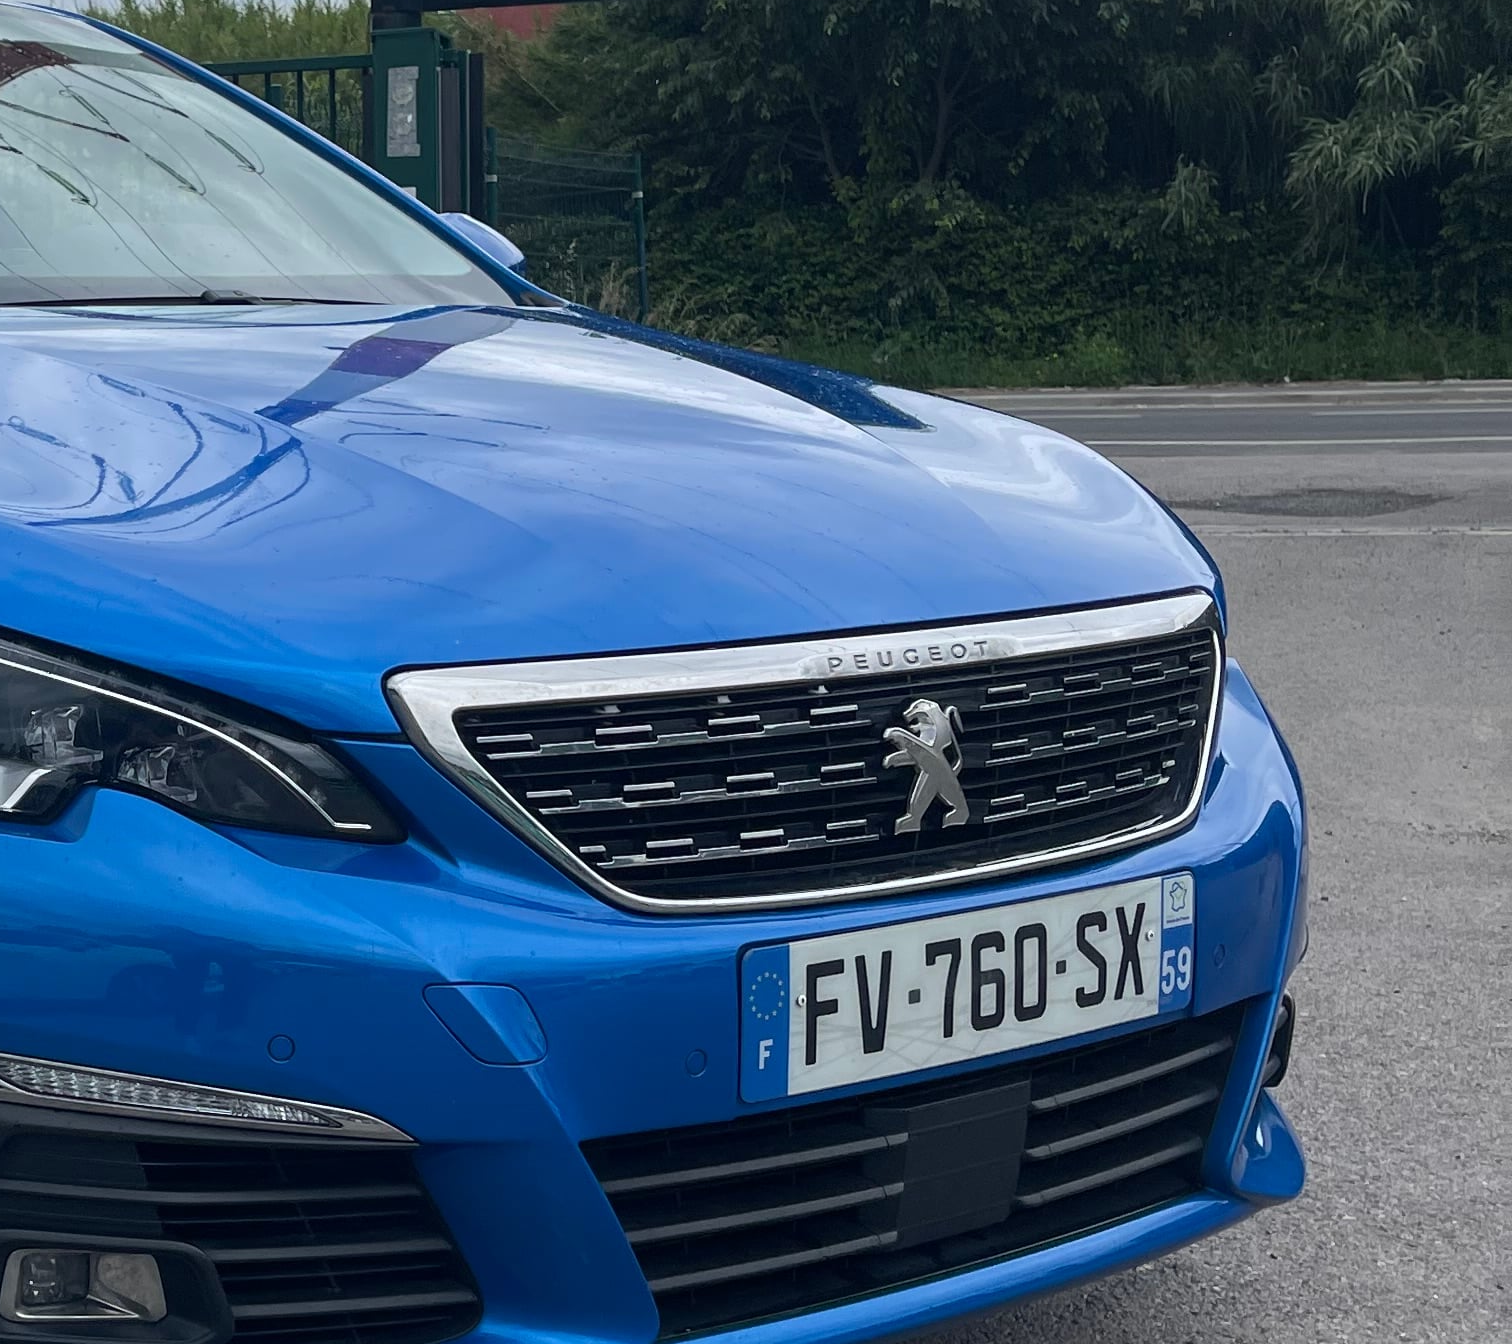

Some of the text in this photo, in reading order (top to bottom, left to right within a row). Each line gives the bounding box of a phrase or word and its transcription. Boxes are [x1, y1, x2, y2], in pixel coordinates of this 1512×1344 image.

[828, 641, 988, 673] PEUGEOT
[1160, 946, 1192, 995] 59
[757, 1038, 774, 1071] F
